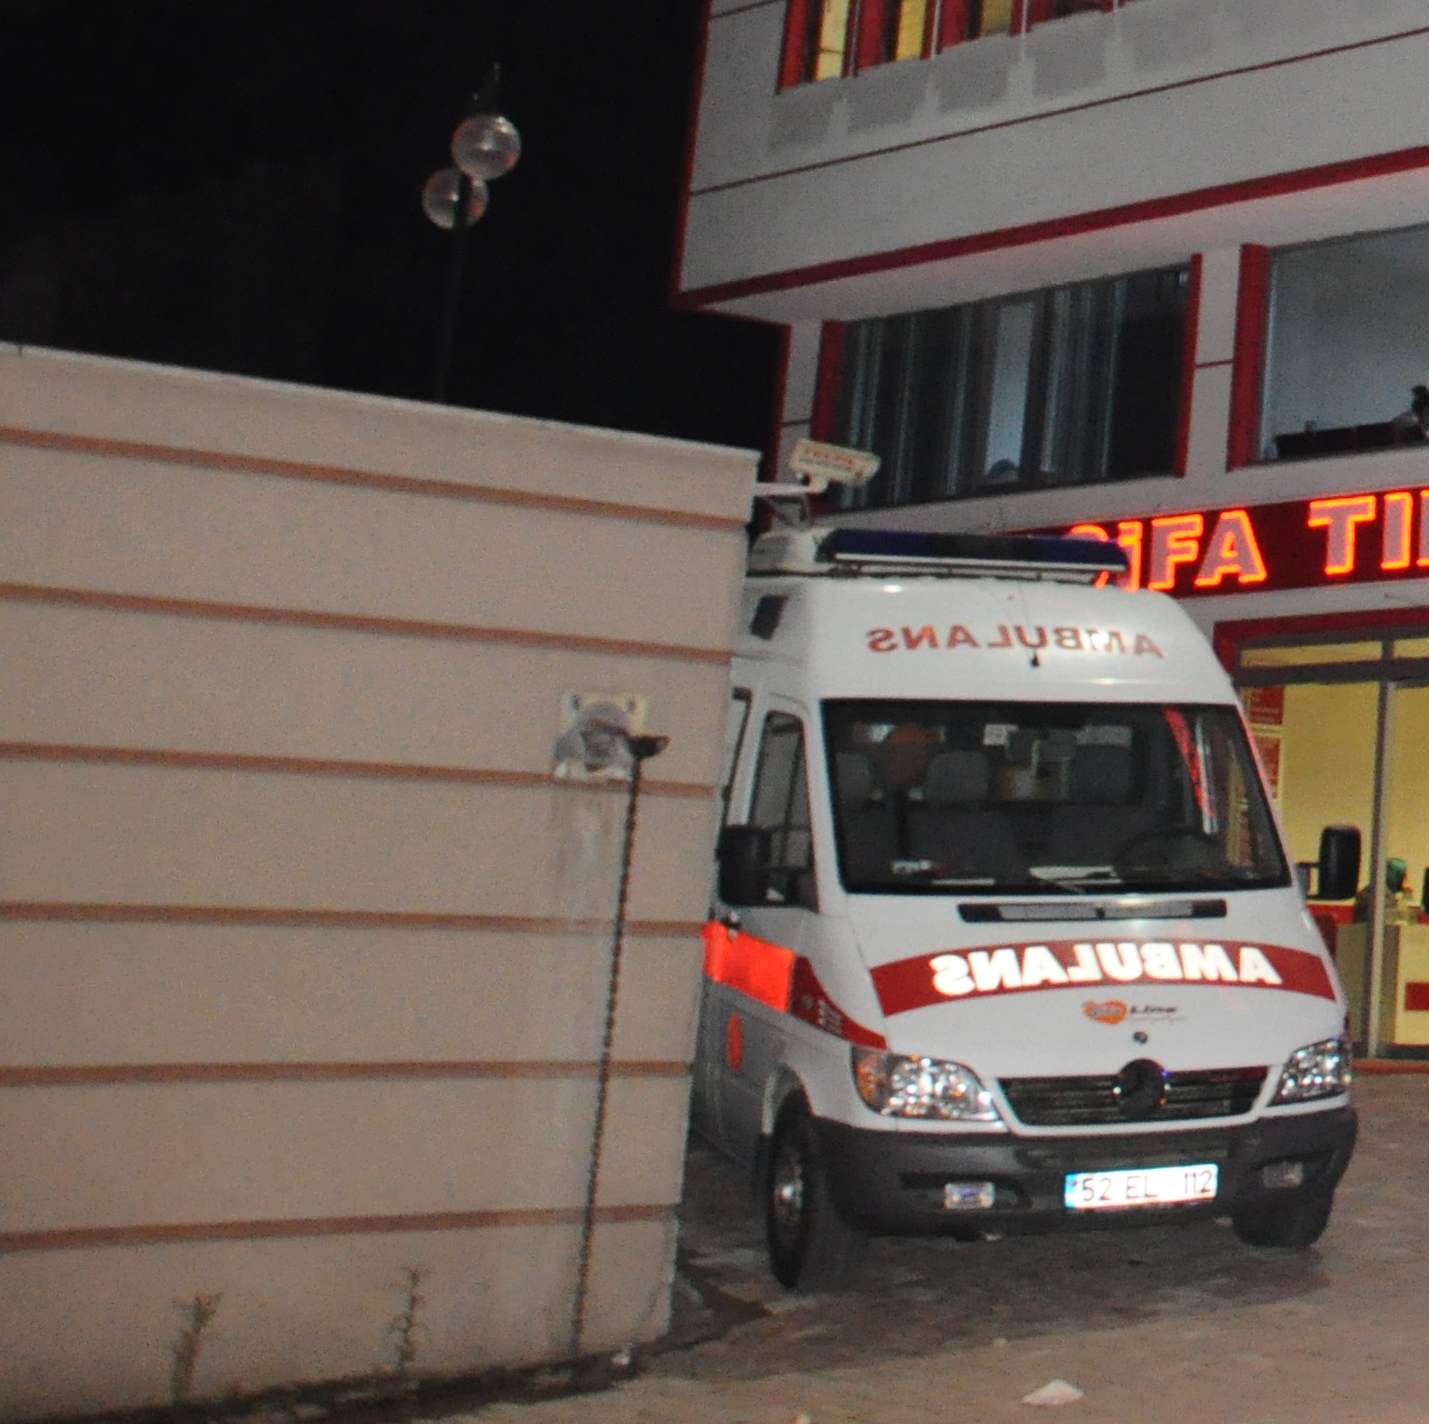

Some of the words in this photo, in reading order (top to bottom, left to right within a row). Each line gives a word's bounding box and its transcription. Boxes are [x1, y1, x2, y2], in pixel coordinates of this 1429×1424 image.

[1067, 508, 1268, 593] İFA
[1082, 1177, 1112, 1202] 52
[1126, 1175, 1159, 1199] EL
[1184, 1170, 1213, 1194] 112
